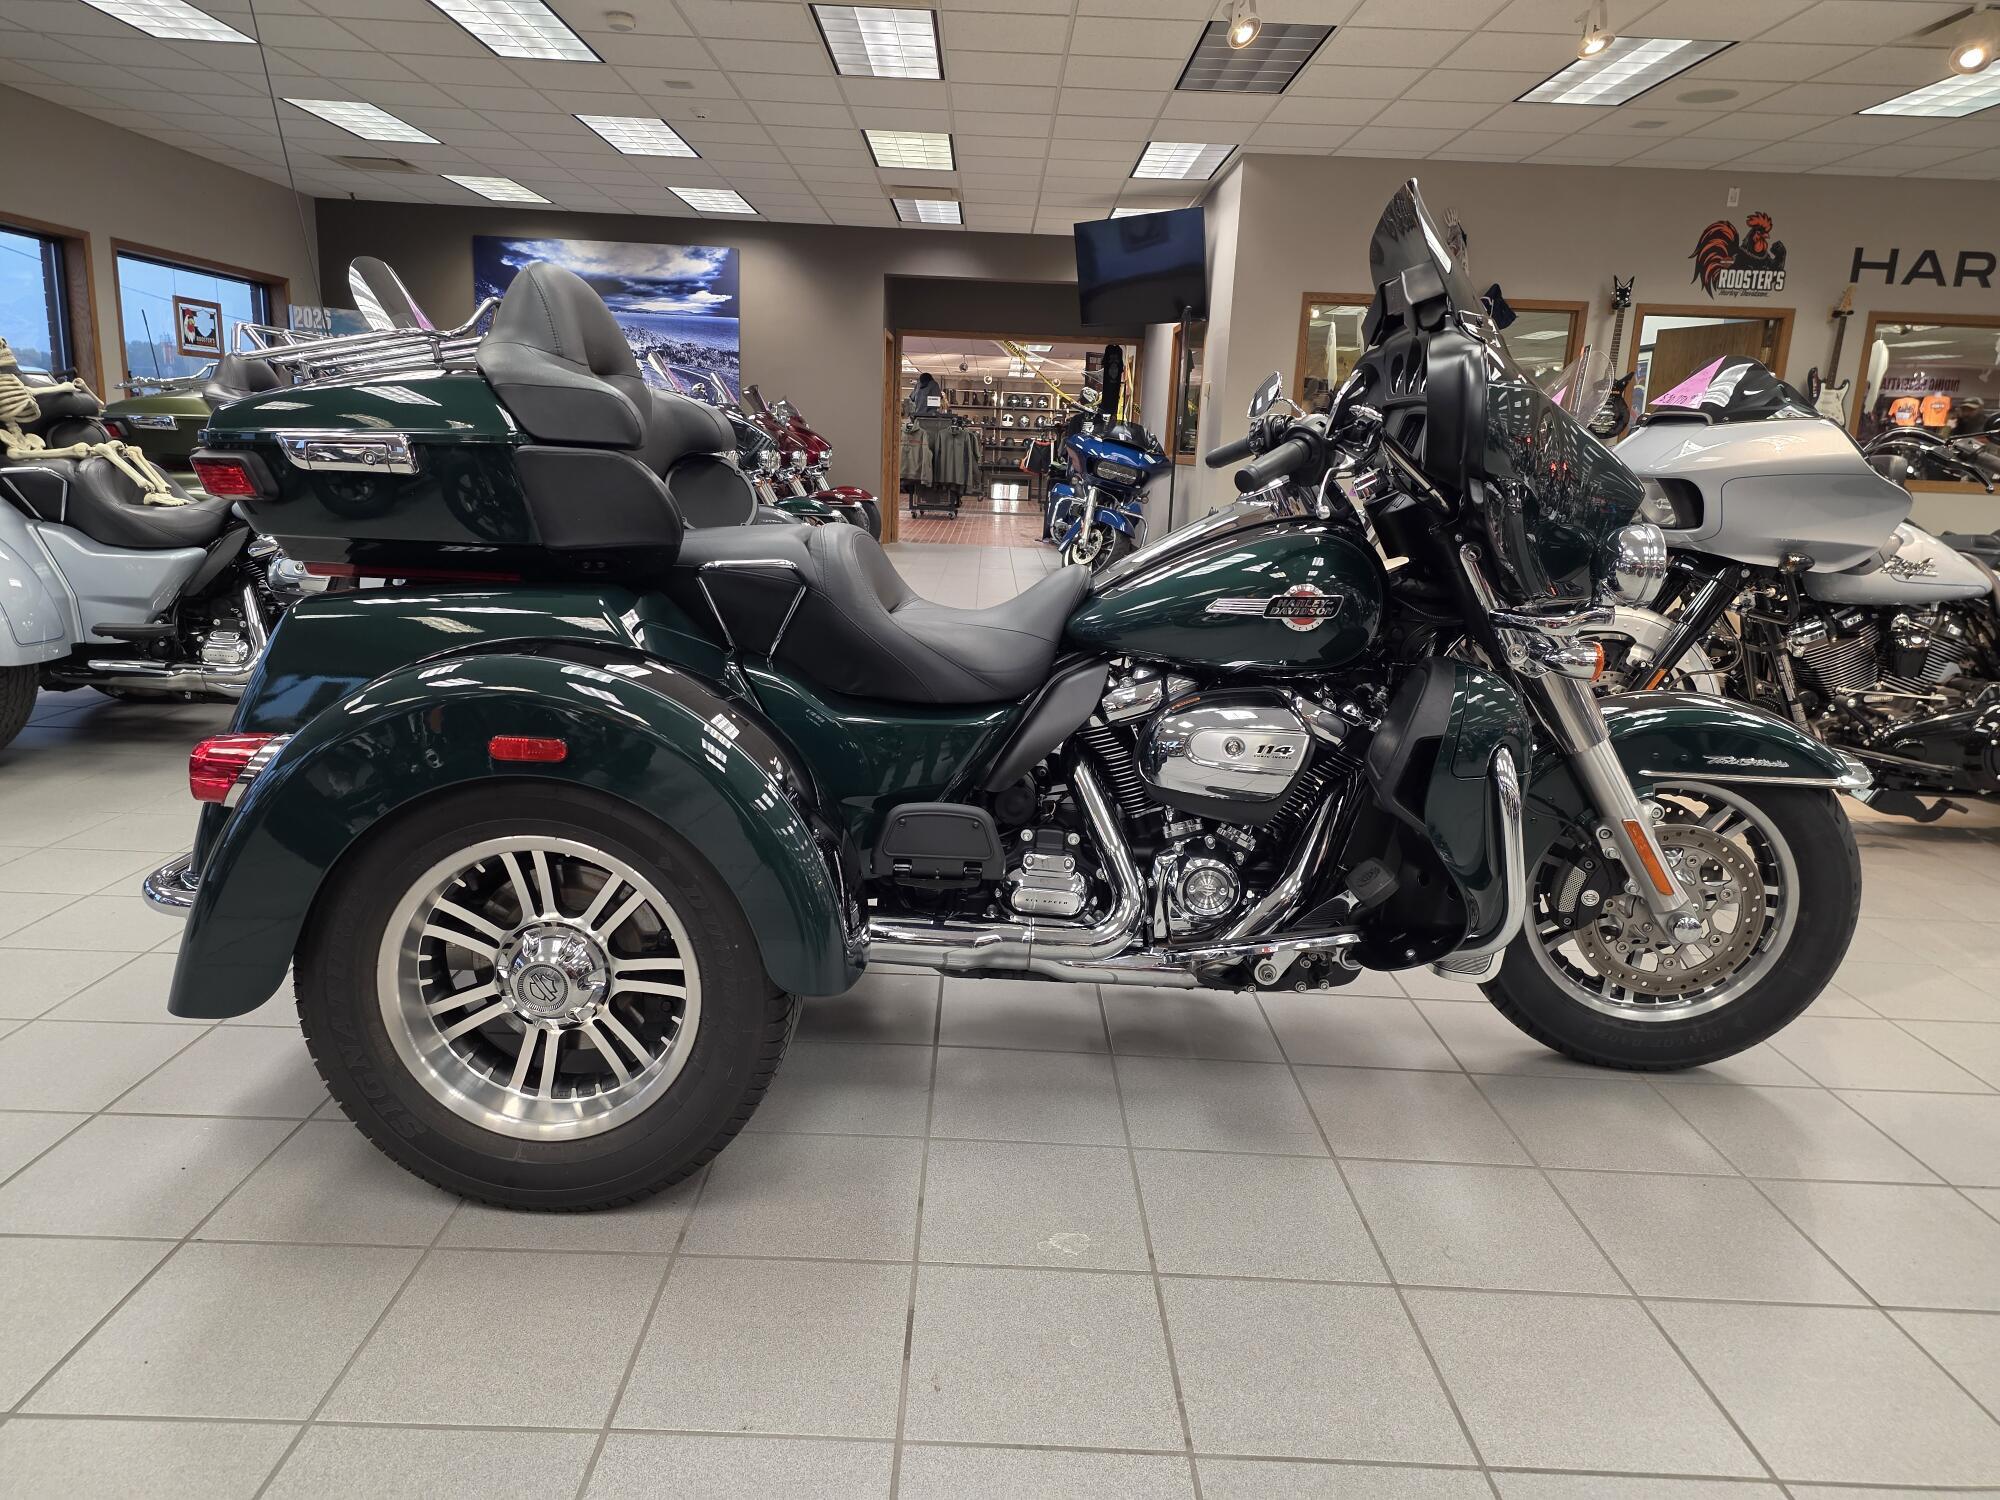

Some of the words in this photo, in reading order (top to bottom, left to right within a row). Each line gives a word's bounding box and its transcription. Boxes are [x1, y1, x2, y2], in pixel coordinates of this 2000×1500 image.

[1849, 247, 1997, 288] HAR
[1718, 269, 1785, 290] ROOSTER'S
[293, 305, 332, 329] 2026
[1269, 607, 1335, 615] DAVIDSON
[1256, 745, 1293, 755] 114
